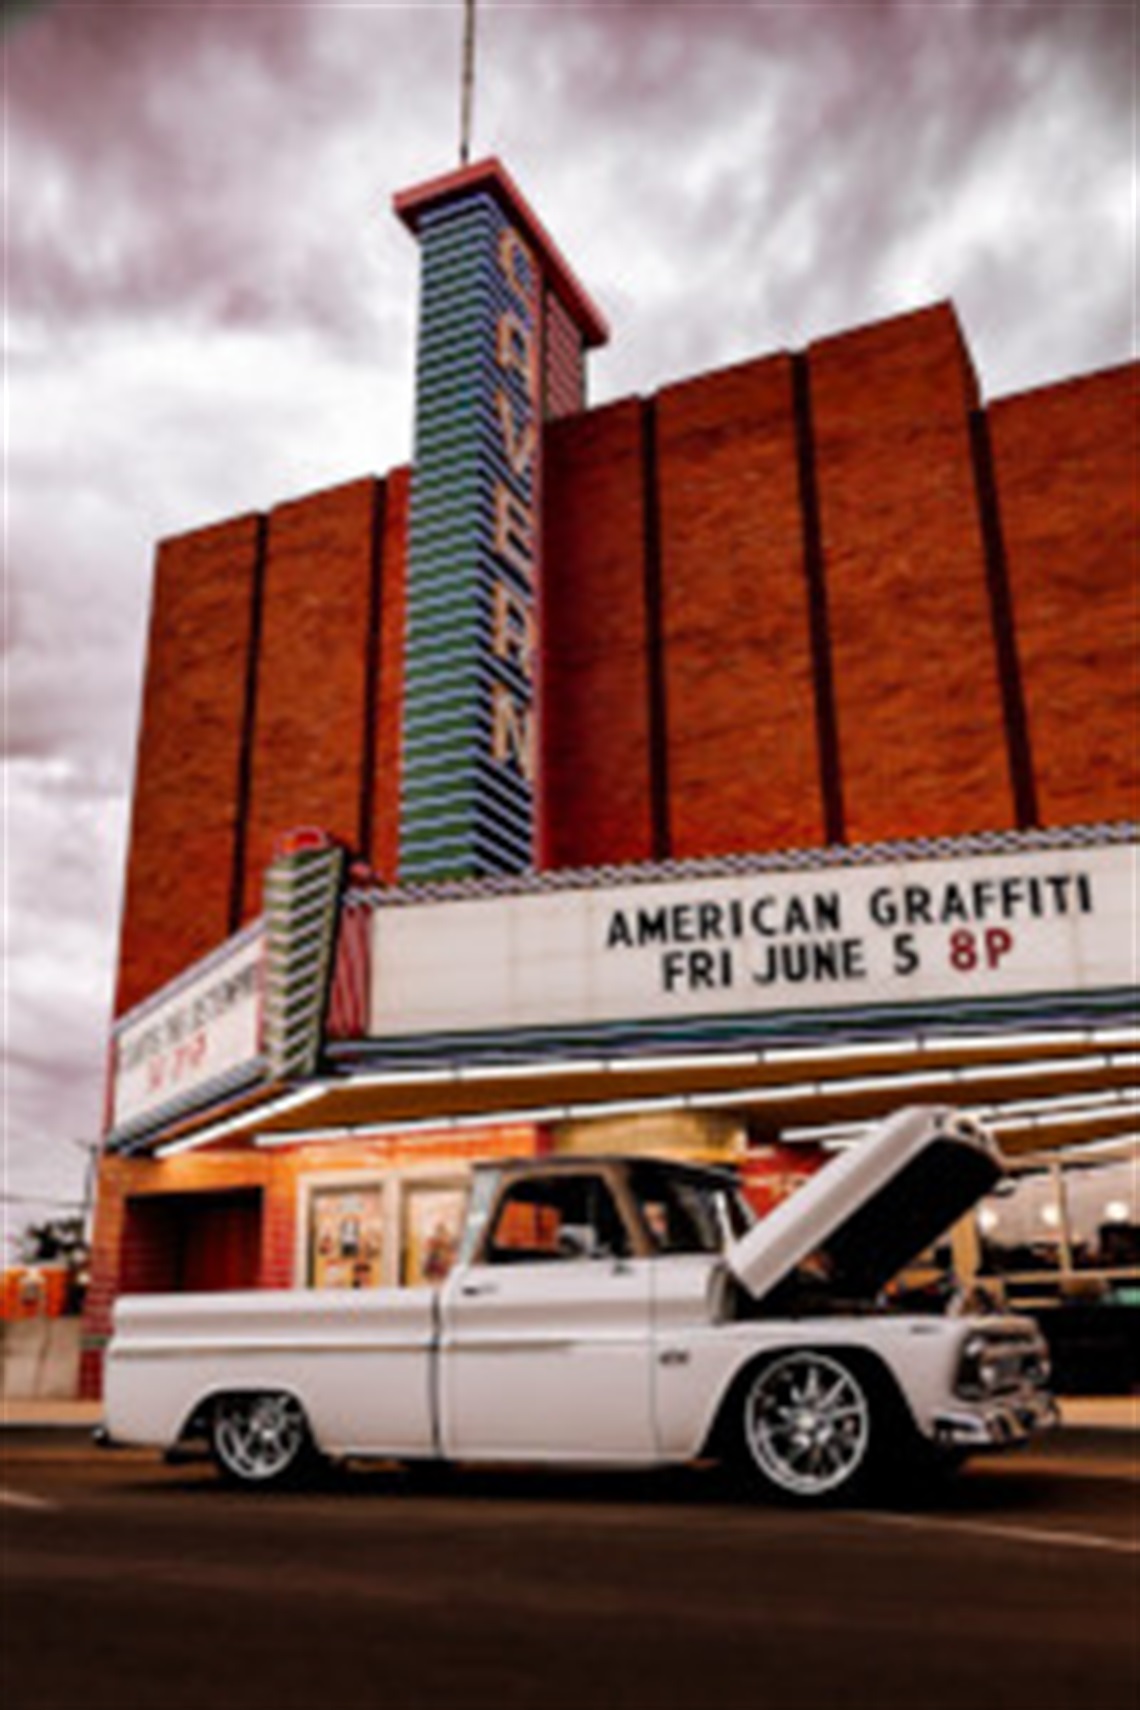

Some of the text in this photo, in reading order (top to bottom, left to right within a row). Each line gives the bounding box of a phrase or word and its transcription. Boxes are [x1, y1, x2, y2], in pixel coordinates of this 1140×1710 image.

[491, 227, 538, 781] CAVERN
[607, 873, 1093, 947] AMERICAN GRAFFITI
[662, 929, 1014, 992] FRI JUNE 5 8P
